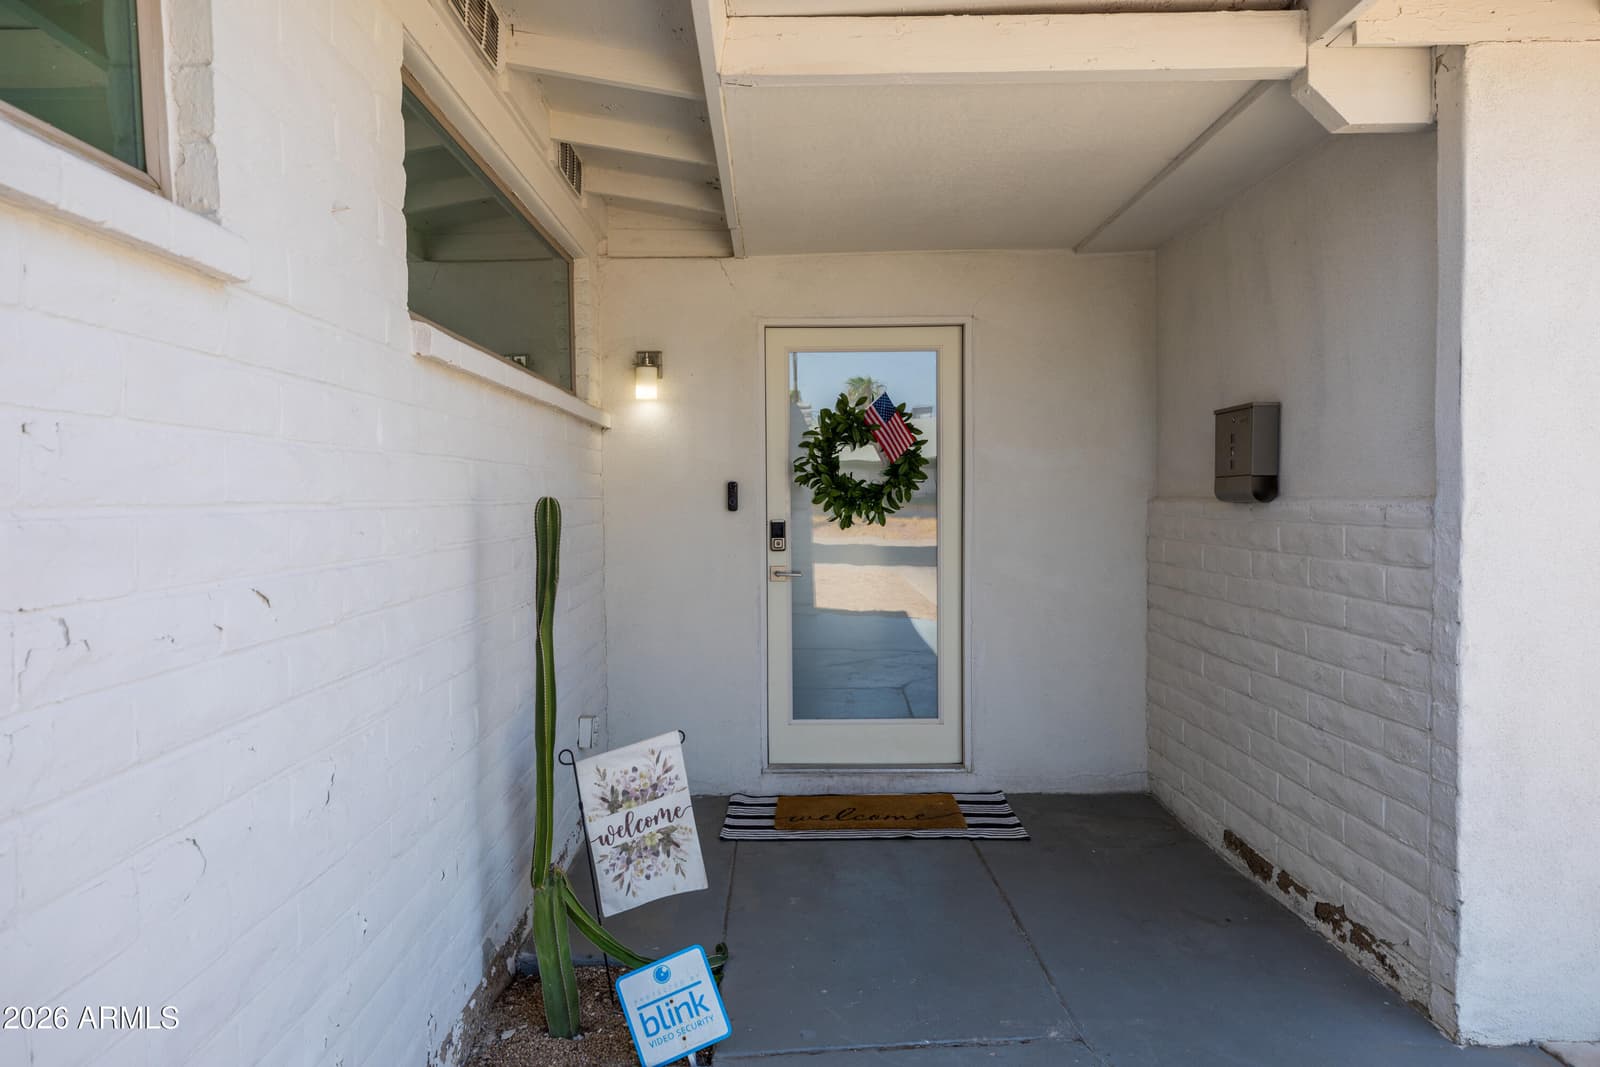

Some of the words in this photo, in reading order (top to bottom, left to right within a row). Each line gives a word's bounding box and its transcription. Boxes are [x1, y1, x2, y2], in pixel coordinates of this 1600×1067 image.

[591, 805, 692, 847] welcome
[781, 807, 959, 823] welcome
[639, 991, 711, 1038] blink
[648, 1032, 675, 1049] VIDEO
[676, 1014, 714, 1037] SECURITY
